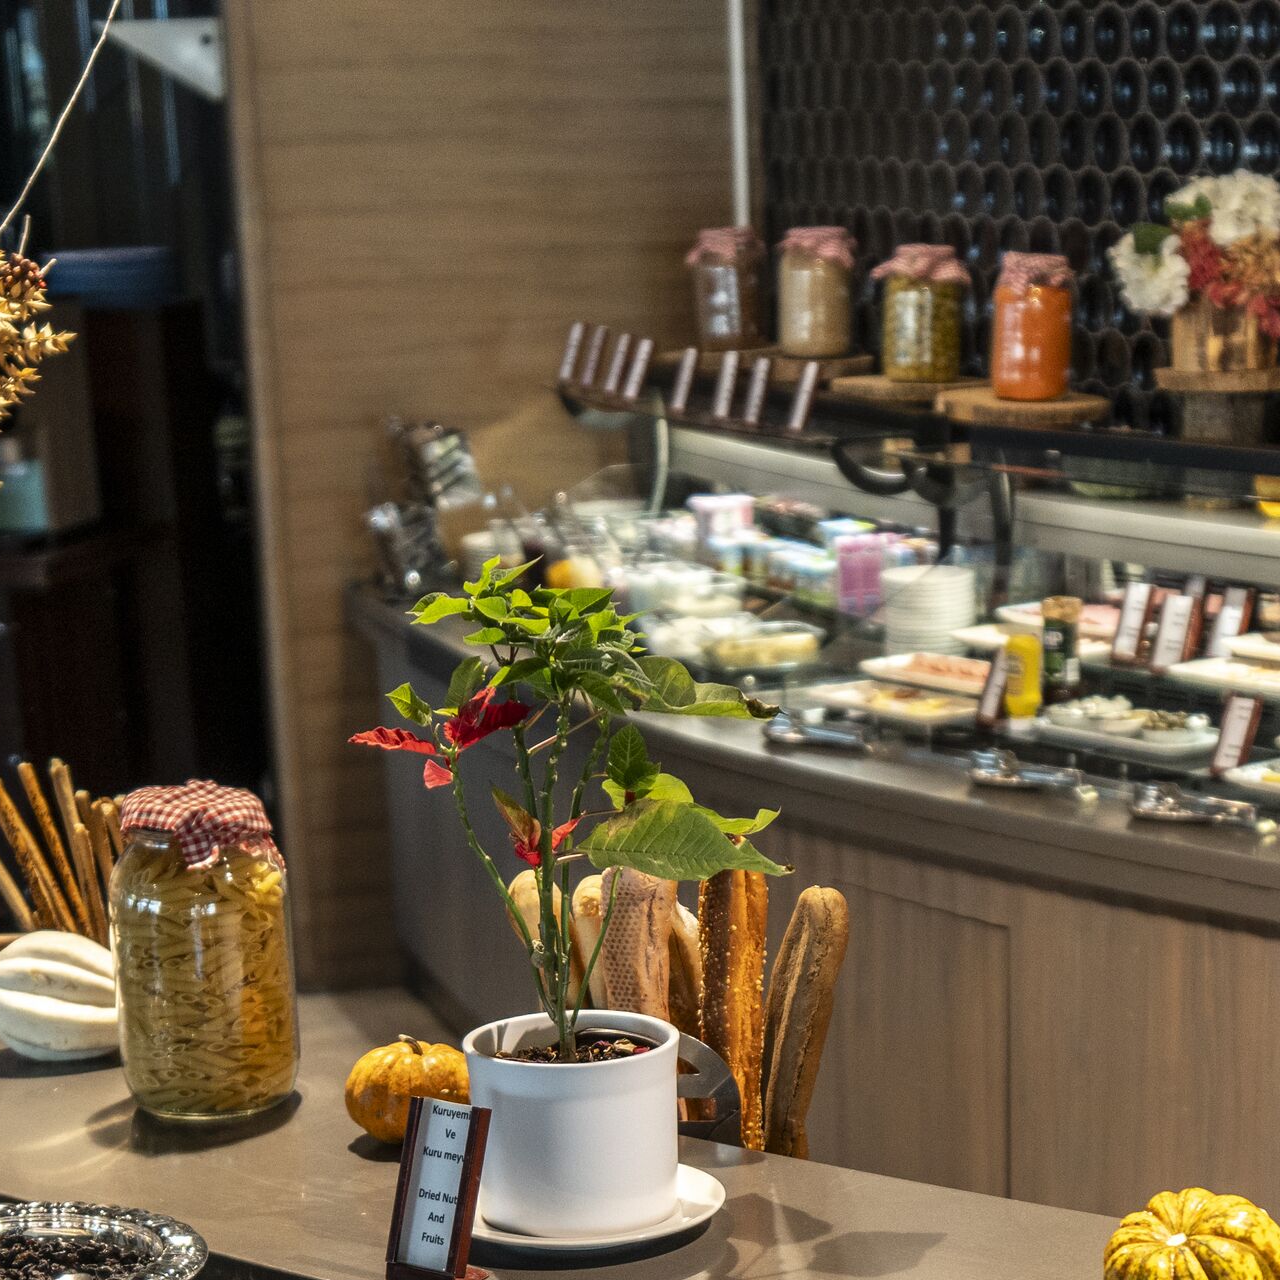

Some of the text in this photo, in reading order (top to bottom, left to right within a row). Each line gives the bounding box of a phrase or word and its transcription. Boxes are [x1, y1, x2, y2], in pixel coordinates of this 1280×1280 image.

[445, 1127, 456, 1140] Ve
[423, 1145, 443, 1159] Kuru
[418, 1187, 441, 1201] Dried
[427, 1211, 445, 1224] And
[421, 1231, 445, 1246] Fruits
